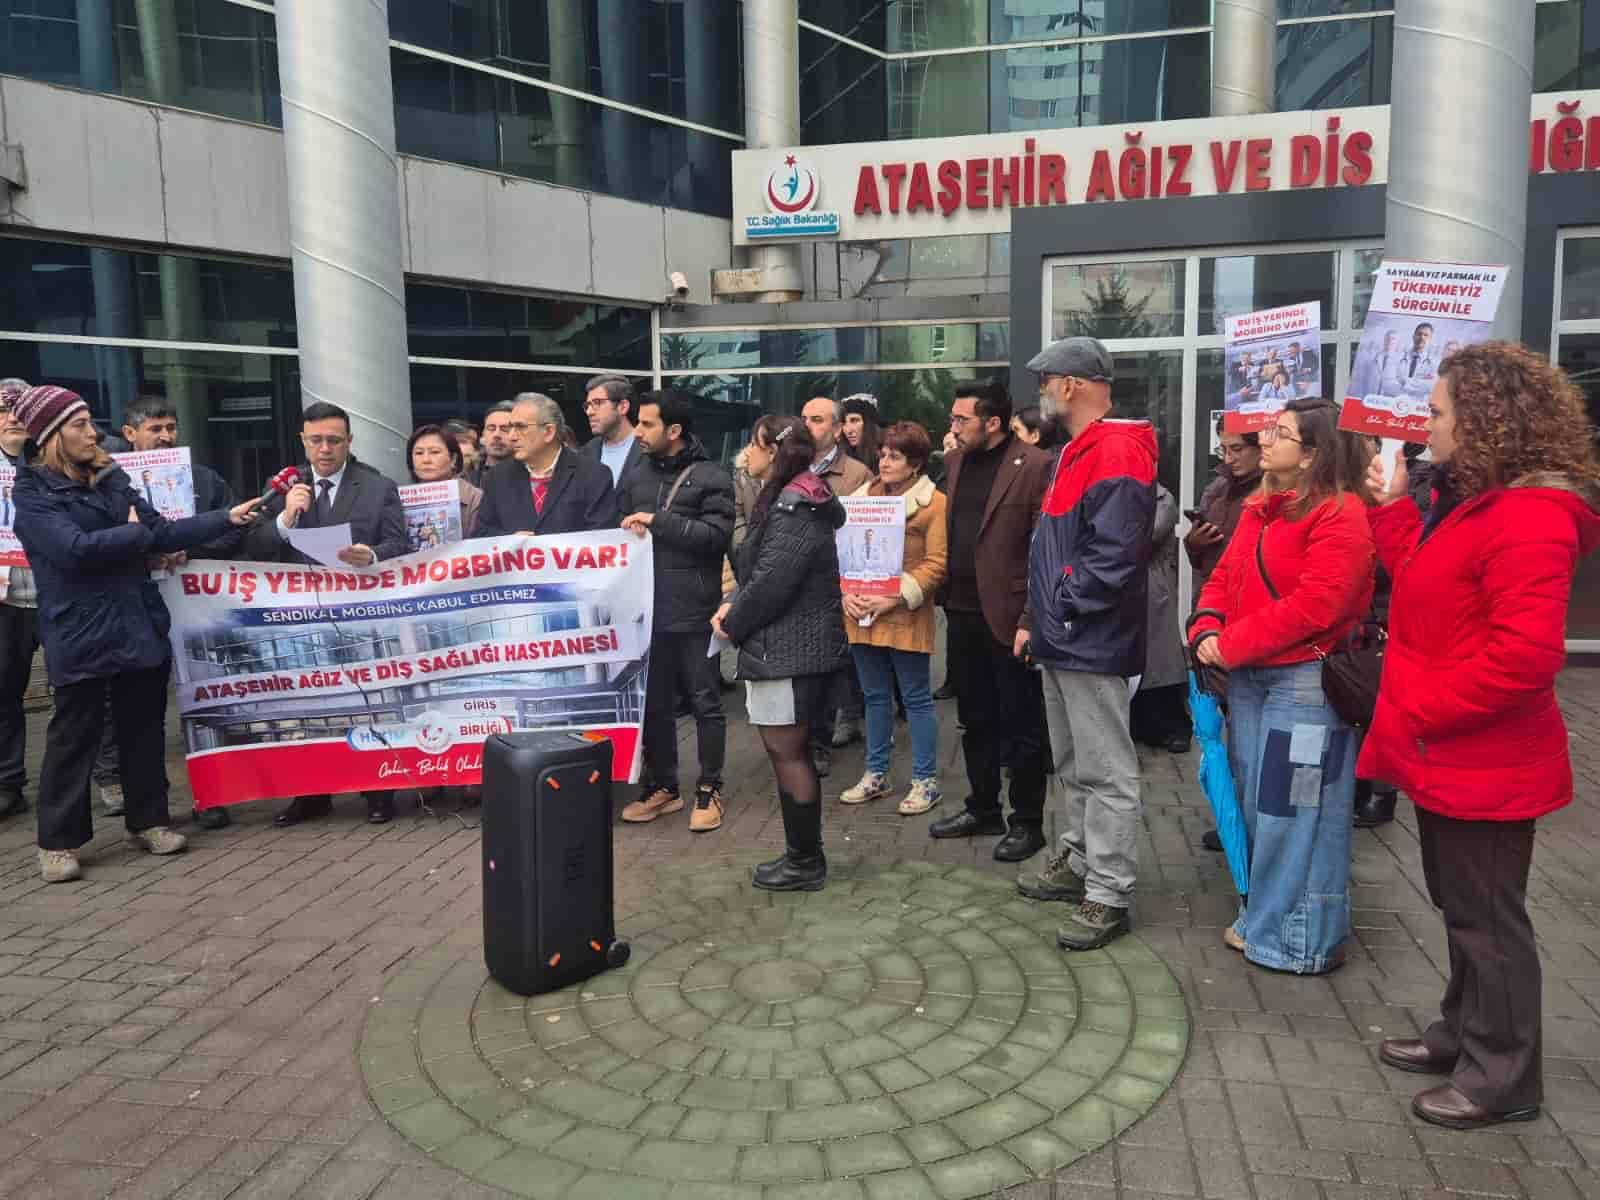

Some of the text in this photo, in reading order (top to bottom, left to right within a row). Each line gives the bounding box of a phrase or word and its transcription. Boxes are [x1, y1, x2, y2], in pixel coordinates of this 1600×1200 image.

[854, 138, 1068, 217] ATAŞEHİR
[1085, 131, 1193, 202] AĞIZ
[1210, 137, 1272, 194] VE
[1441, 271, 1481, 281] PARMAK
[1392, 278, 1483, 297] TÜKENMEYİZ
[1392, 296, 1449, 313] SÜRGÜN
[182, 543, 628, 602] BU İŞ YERİNDE MOBBİNG VAR!
[342, 600, 414, 617] MOBBİNG
[417, 597, 466, 611] KABUL
[194, 629, 618, 701] ATAŞEHİR AĞIZ VE DİŞ SAĞLIĞI HASTANESİ
